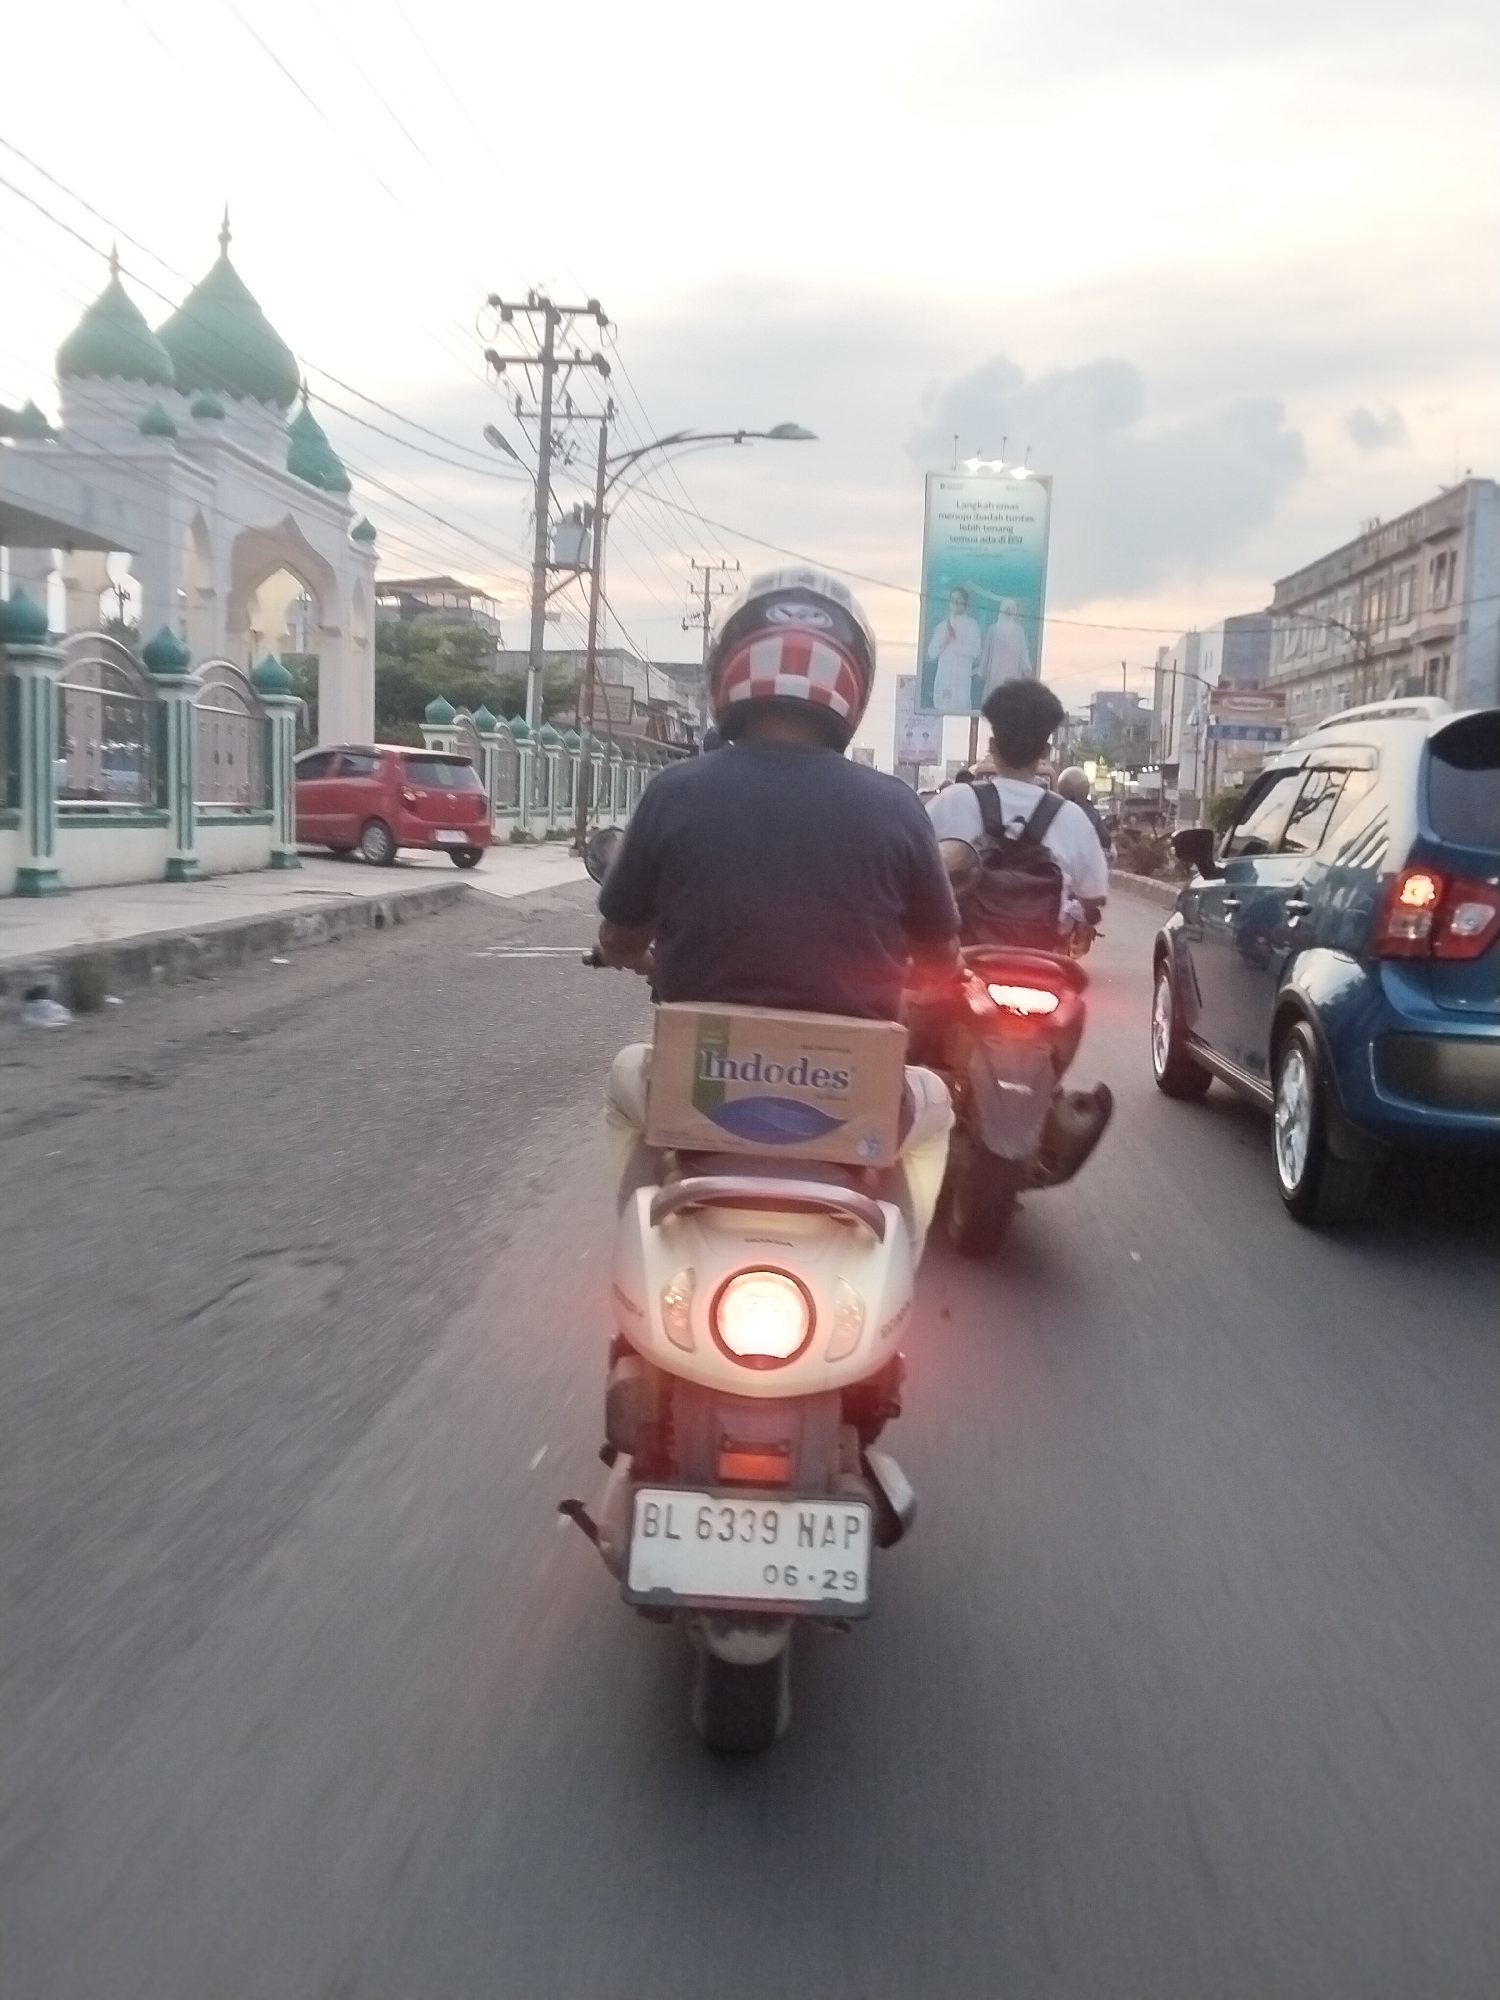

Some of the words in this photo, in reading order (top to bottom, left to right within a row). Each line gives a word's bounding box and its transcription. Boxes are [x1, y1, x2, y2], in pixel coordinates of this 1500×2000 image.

[956, 500, 994, 510] Langkah
[995, 502, 1019, 510] emas
[938, 512, 972, 521] menuju
[973, 512, 1004, 521] ibadah
[959, 523, 981, 531] lebih
[983, 524, 1014, 533] tenang
[949, 535, 978, 543] semua
[980, 535, 997, 544] ada
[997, 535, 1006, 544] di
[700, 1050, 850, 1090] Indodes
[643, 1502, 681, 1540] BL
[696, 1505, 780, 1544] 6339
[798, 1511, 860, 1550] NAP
